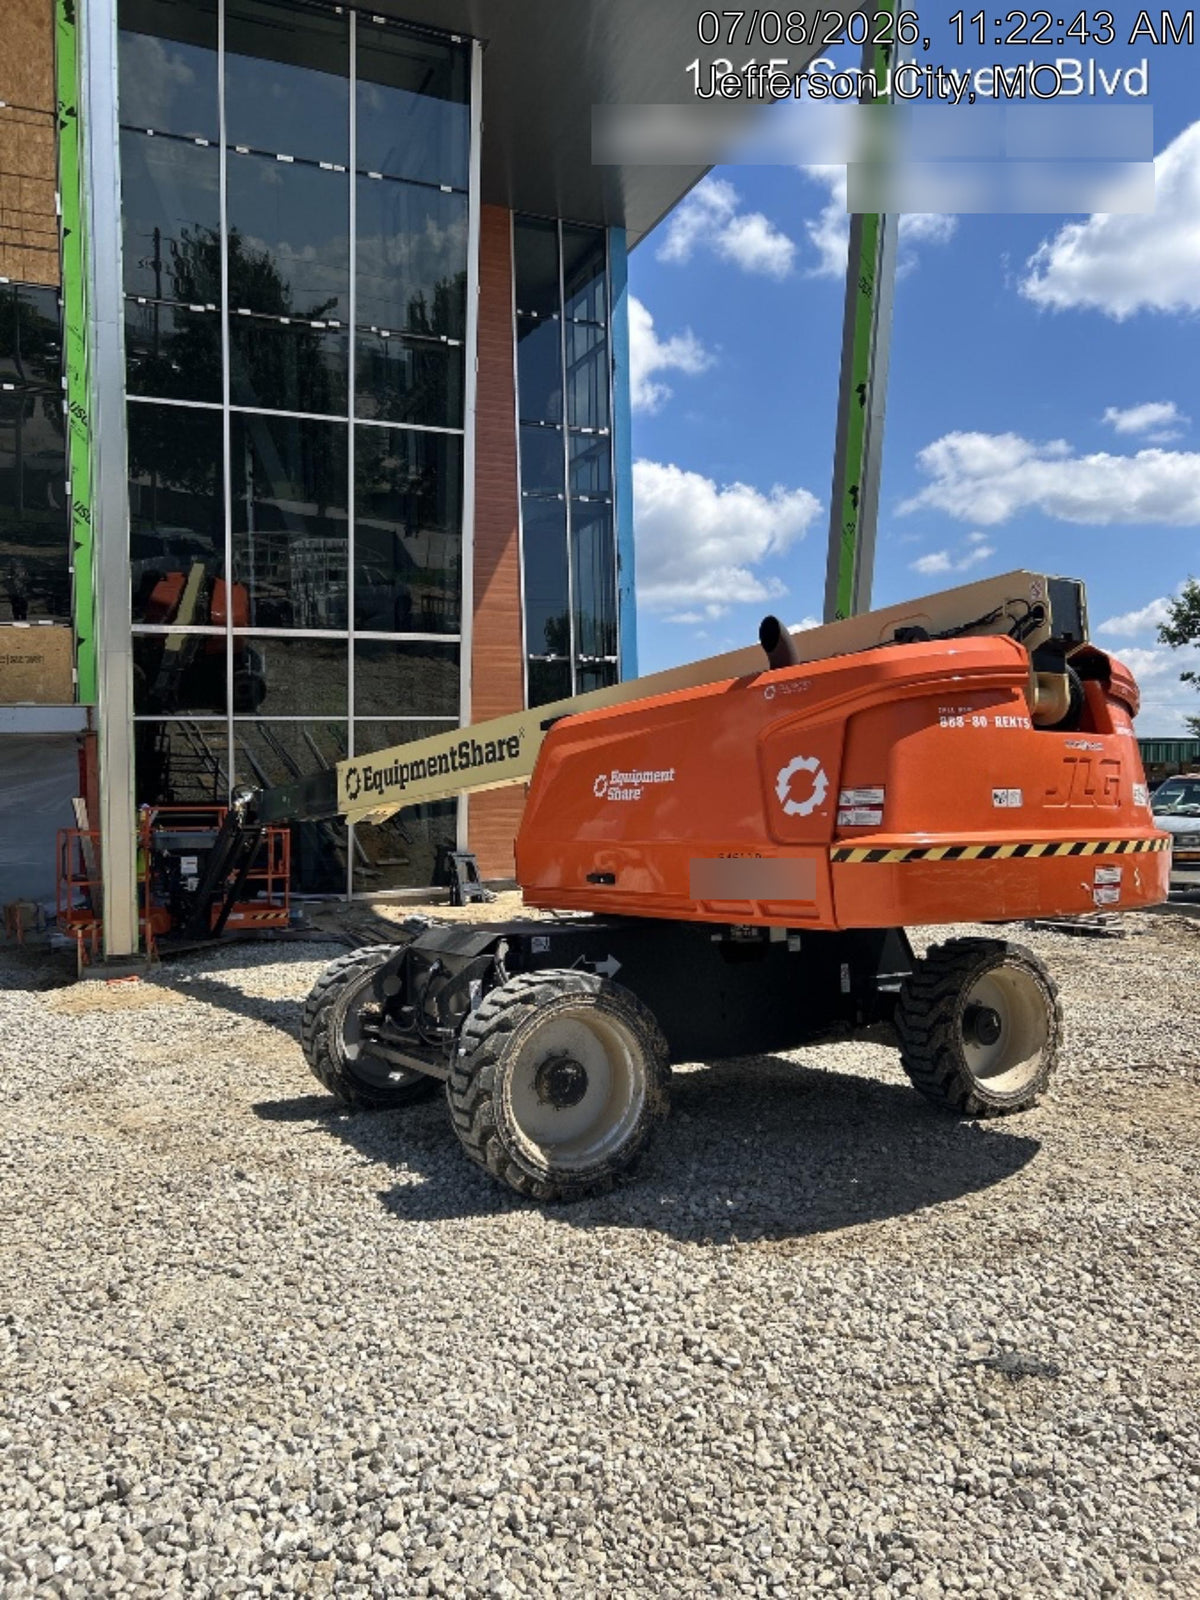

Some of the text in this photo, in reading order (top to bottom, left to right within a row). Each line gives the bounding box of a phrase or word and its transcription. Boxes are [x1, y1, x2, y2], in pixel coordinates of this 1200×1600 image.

[363, 735, 520, 795] EquipmentShare
[609, 767, 675, 787] Equipment
[1042, 757, 1121, 808] JLG
[607, 786, 641, 801] Share
